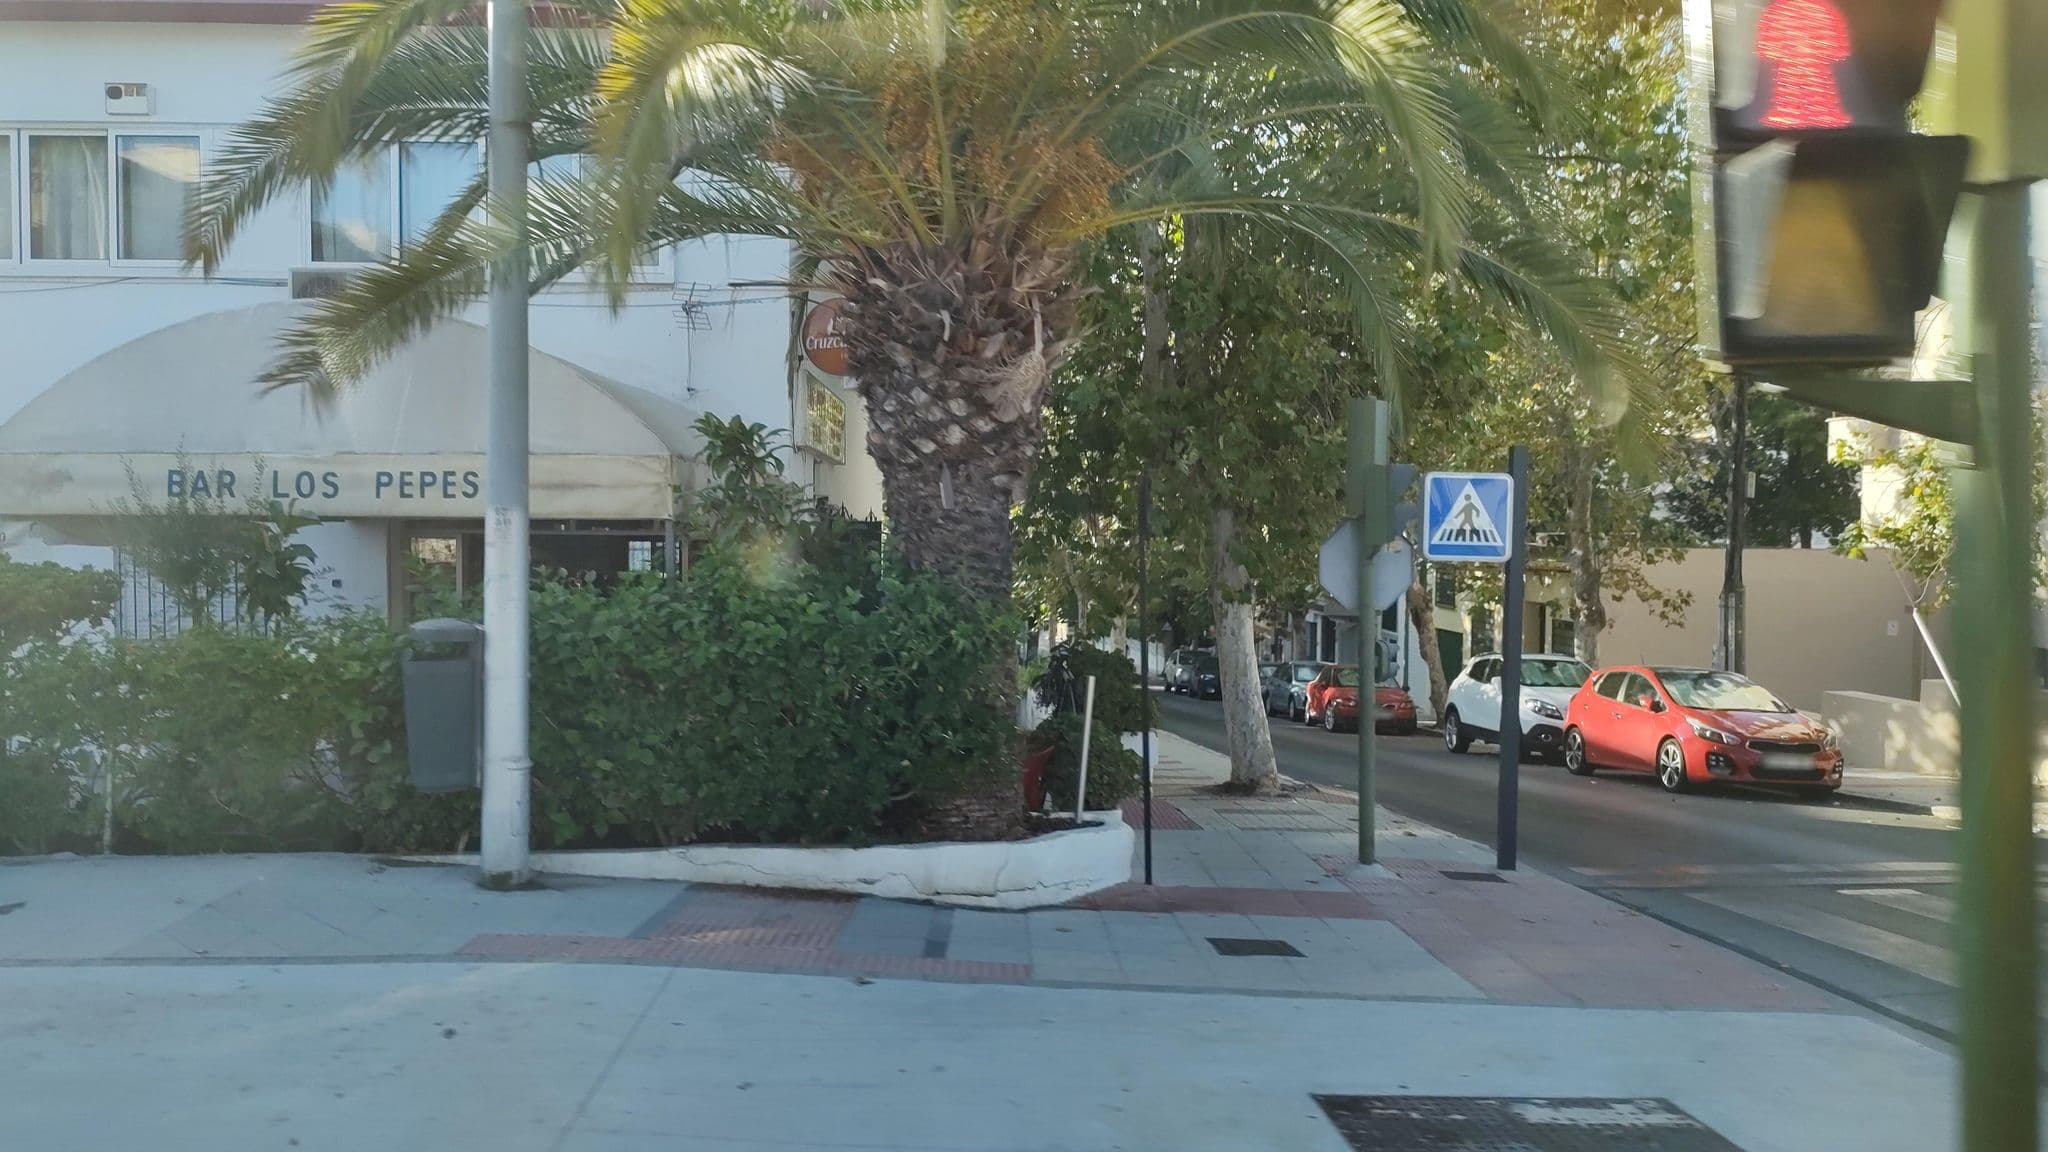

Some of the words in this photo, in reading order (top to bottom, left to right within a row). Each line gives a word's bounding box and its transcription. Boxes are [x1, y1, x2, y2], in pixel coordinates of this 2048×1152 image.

[167, 470, 236, 499] BAR
[272, 470, 340, 499] LOS
[375, 470, 480, 499] PEPES
